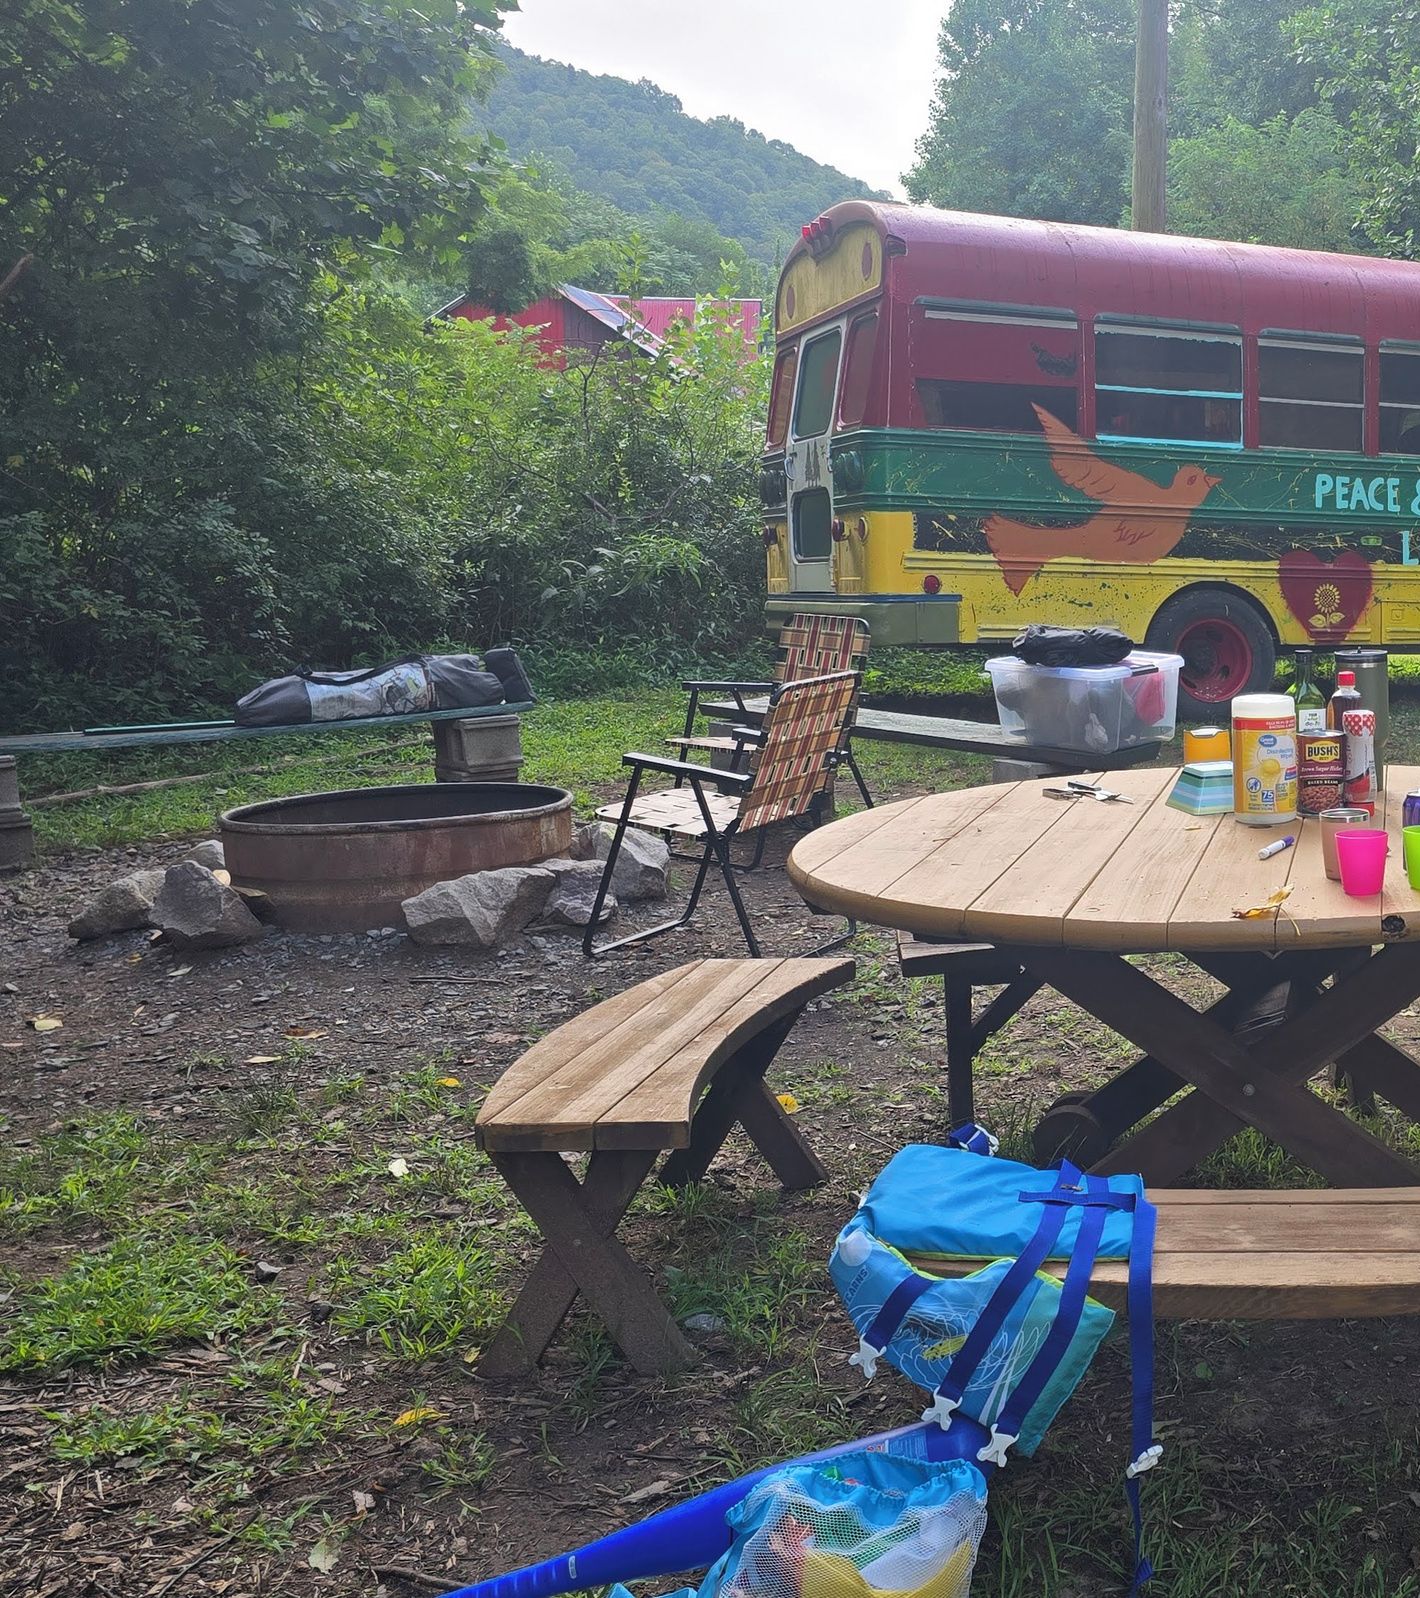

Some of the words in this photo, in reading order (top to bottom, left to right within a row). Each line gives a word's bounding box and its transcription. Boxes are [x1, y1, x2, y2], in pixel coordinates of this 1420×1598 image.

[1315, 473, 1401, 513] PEACE
[1307, 746, 1339, 757] BUSH'S
[1262, 790, 1274, 798] 75
